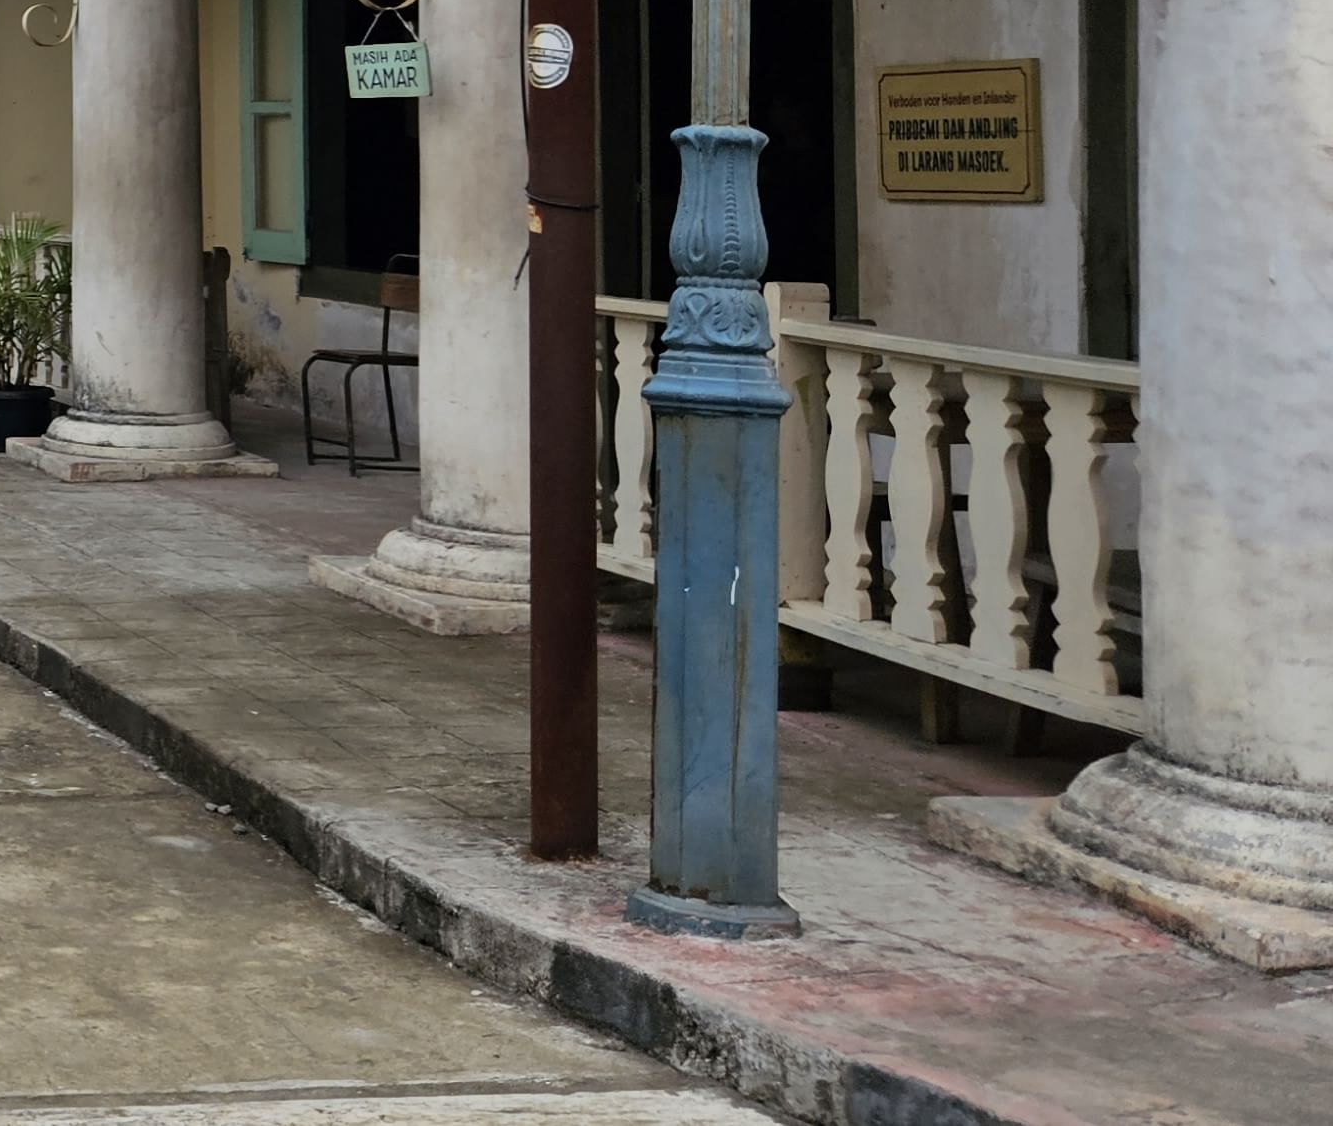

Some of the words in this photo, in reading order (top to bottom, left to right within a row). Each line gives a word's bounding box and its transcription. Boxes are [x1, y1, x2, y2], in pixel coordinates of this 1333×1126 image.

[353, 51, 388, 65] MASIH
[394, 49, 418, 62] ADA
[356, 66, 419, 90] KAMAR
[888, 119, 939, 140] PRIBOEMI
[943, 118, 965, 139] DAN
[968, 117, 1018, 139] ANDJING
[899, 151, 909, 172] DI
[912, 151, 954, 172] LARANG
